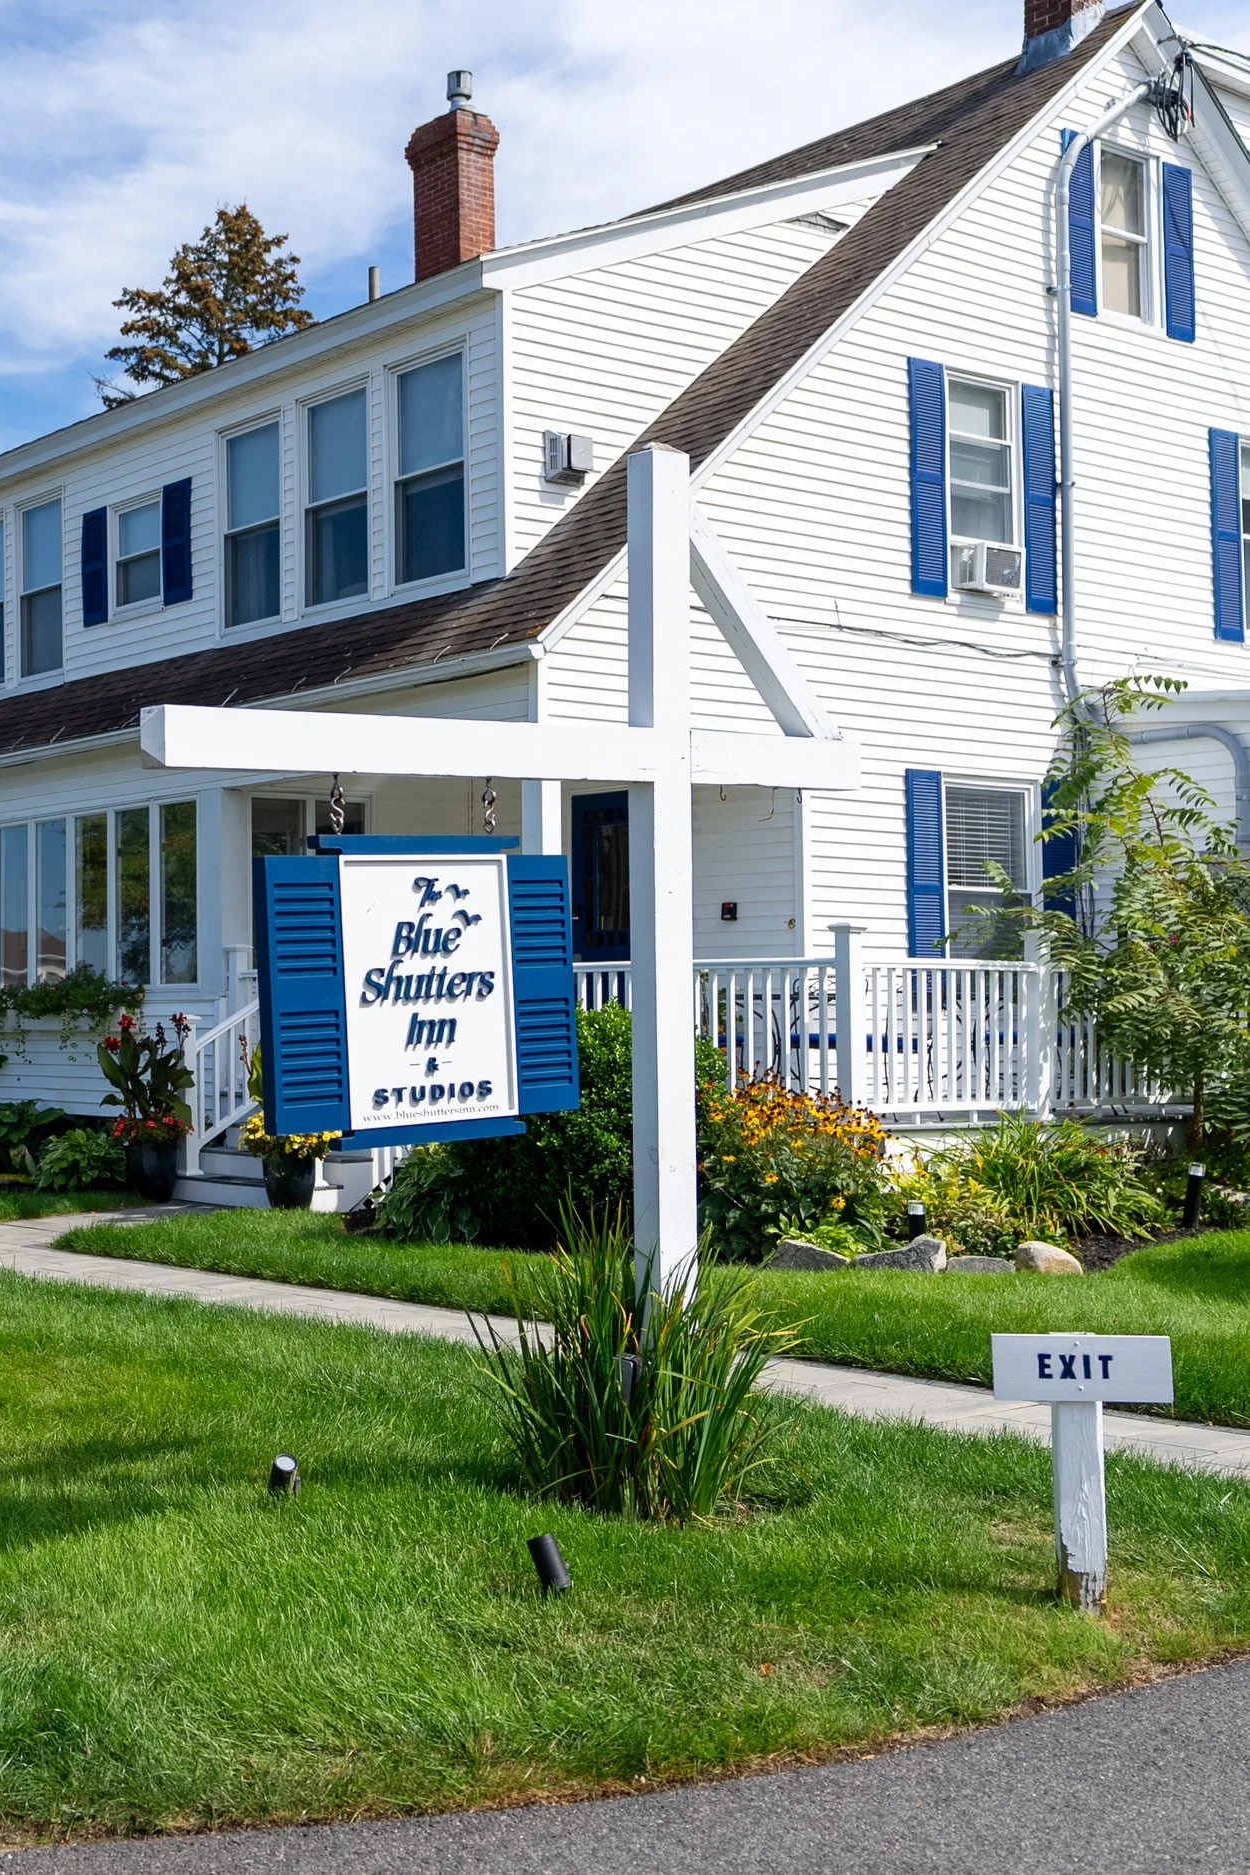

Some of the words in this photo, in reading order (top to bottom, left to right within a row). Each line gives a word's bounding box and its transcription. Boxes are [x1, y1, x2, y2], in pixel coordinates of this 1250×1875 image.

[413, 877, 443, 908] The
[392, 912, 462, 956] Blue
[359, 959, 495, 1003] Shutters
[408, 1012, 457, 1045] Inn
[373, 1080, 493, 1106] STUDIOS
[363, 1104, 500, 1122] www.blueshuttersinn.com
[1037, 1353, 1113, 1380] EXIT
